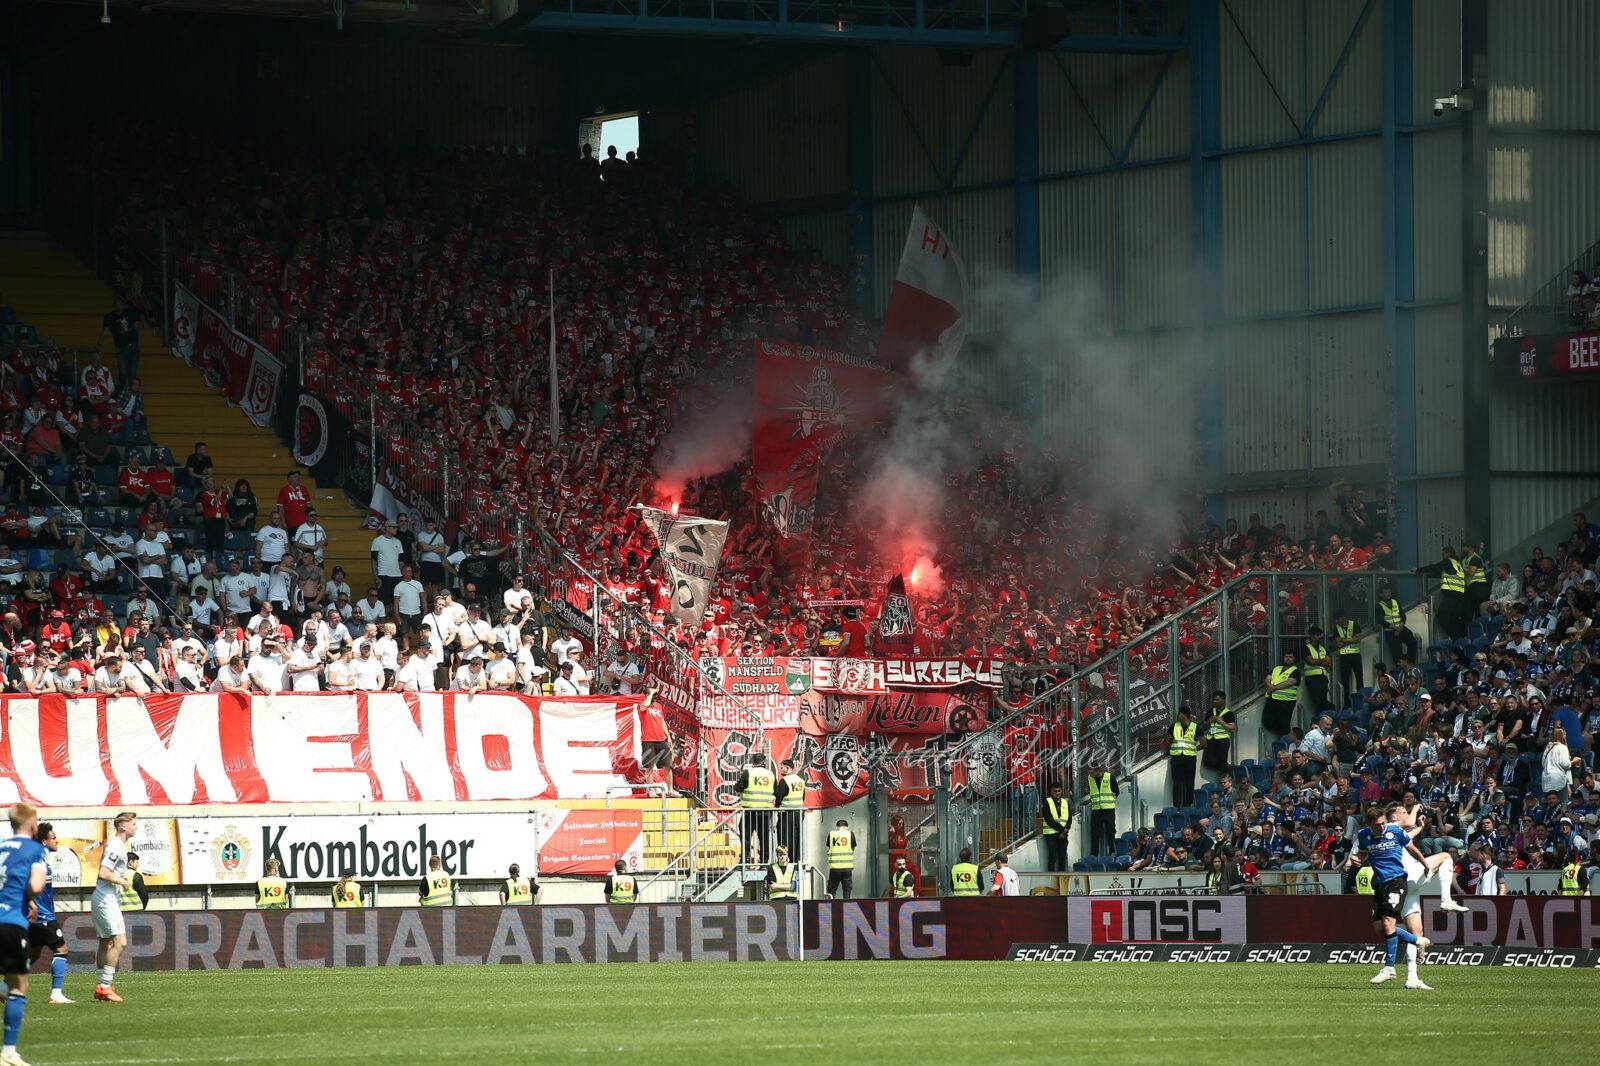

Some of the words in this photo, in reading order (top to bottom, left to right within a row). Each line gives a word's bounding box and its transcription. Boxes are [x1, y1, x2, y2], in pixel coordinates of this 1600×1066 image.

[1569, 337, 1600, 369] BEE
[128, 477, 144, 487] HFC
[709, 605, 726, 614] HFC
[50, 635, 66, 643] HFC
[737, 656, 775, 665] SEKTION
[728, 666, 783, 676] MANSFELD
[886, 660, 1003, 683] SURREALE
[732, 681, 780, 693] SÜDHARZ
[701, 708, 797, 724] QUERFURT
[1131, 713, 1168, 733] urrender
[831, 737, 855, 748] HFC
[754, 776, 769, 786] K9
[833, 836, 848, 847] K9
[130, 842, 170, 854] Krombacher
[262, 823, 475, 879] Krombacher
[433, 877, 448, 889] K9
[956, 872, 971, 882] K9
[264, 887, 281, 897] K9
[514, 884, 528, 896] K9
[615, 881, 631, 891] K9
[62, 900, 947, 973] SPRACHALARMIERUNG
[1014, 945, 1076, 962] SCHÜCO
[1091, 946, 1154, 963] SCHÜCO
[1168, 946, 1231, 963] SCHÜCO
[1246, 945, 1311, 963] SCHÜCO
[1503, 950, 1575, 968] SCHÜCO
